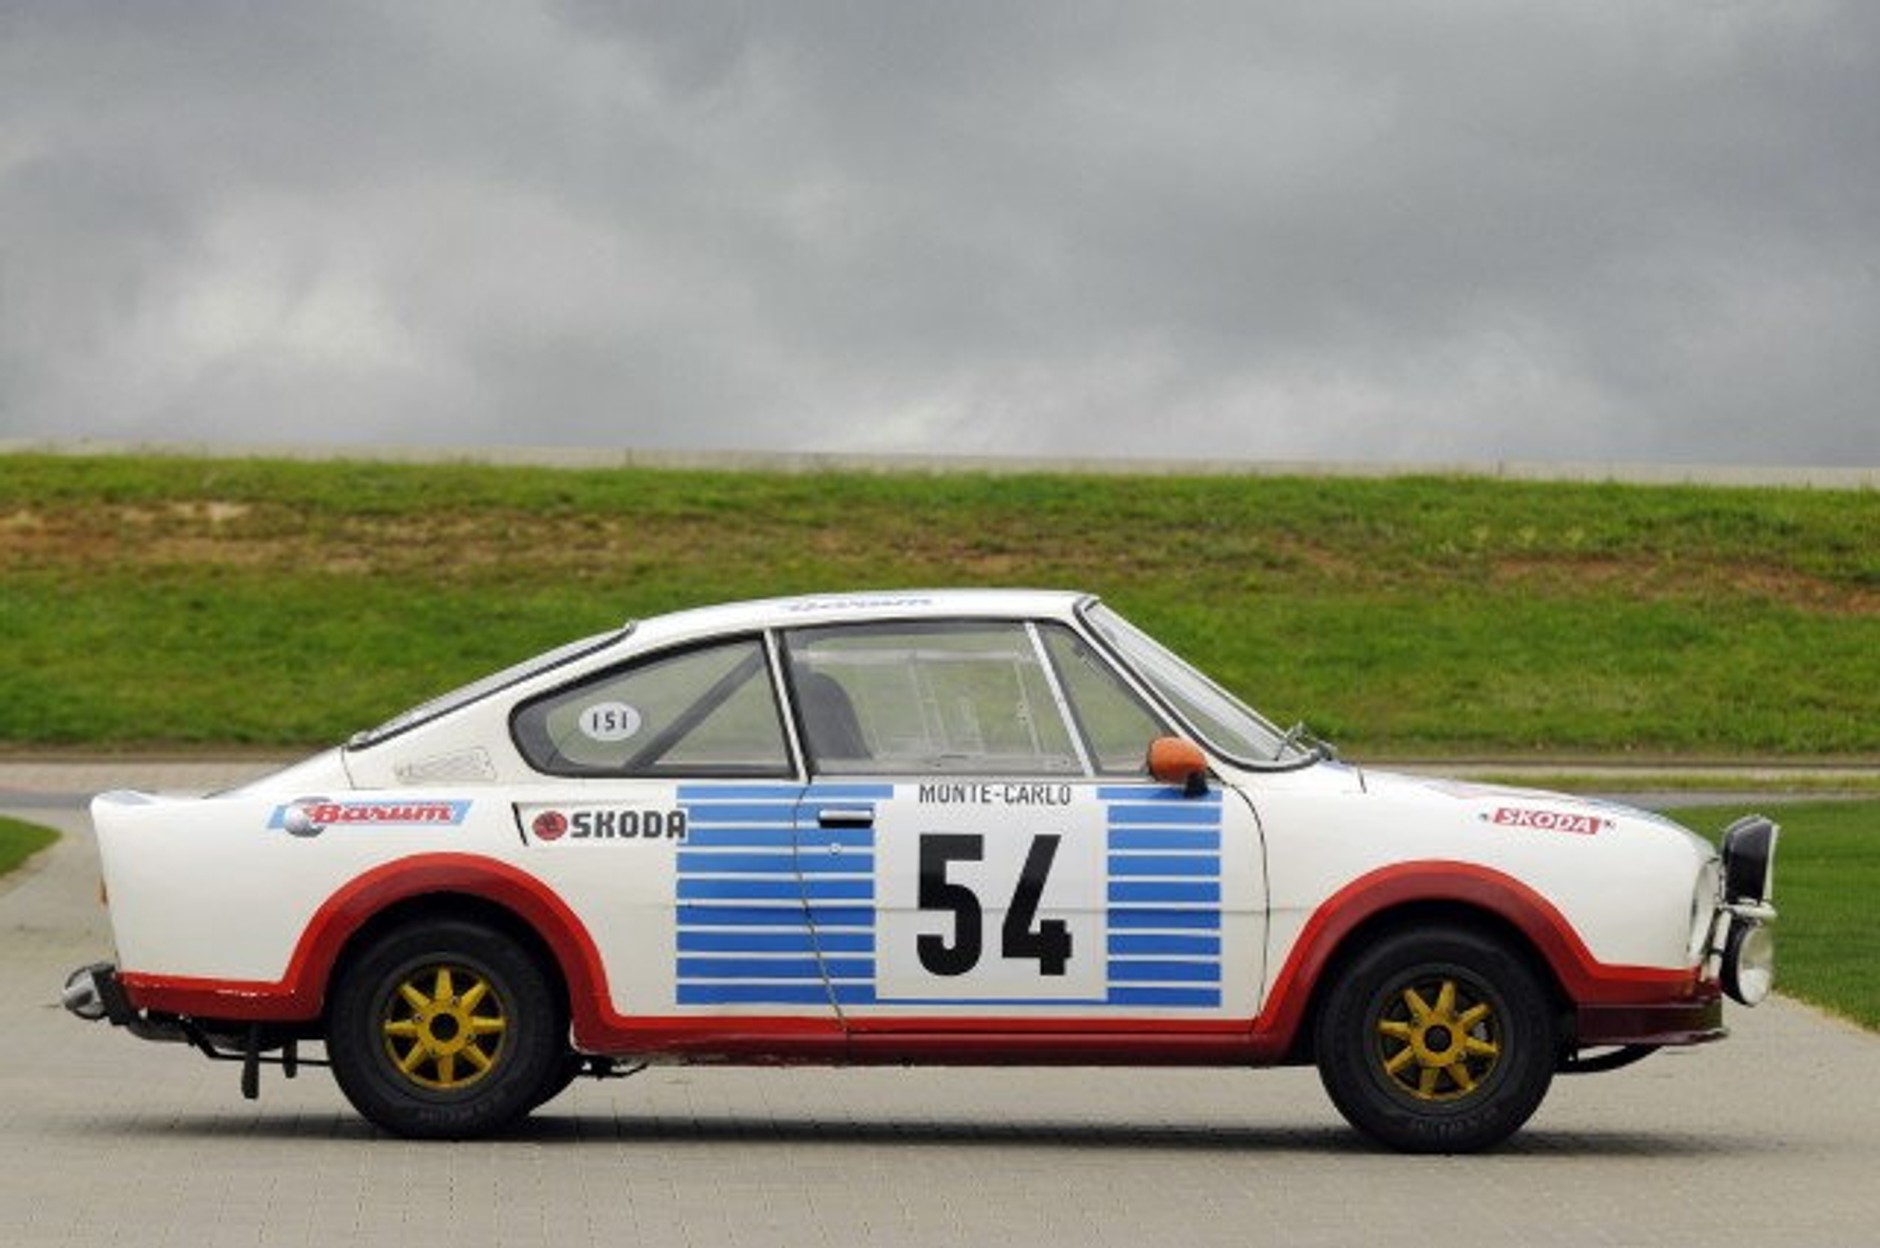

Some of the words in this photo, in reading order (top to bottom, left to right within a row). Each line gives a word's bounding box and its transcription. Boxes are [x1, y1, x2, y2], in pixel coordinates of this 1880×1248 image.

[919, 784, 1071, 806] MONTE-CARLO
[305, 803, 453, 824] Barum
[570, 810, 687, 839] SKODA
[1498, 809, 1594, 833] SKODA
[917, 834, 1073, 976] 54
